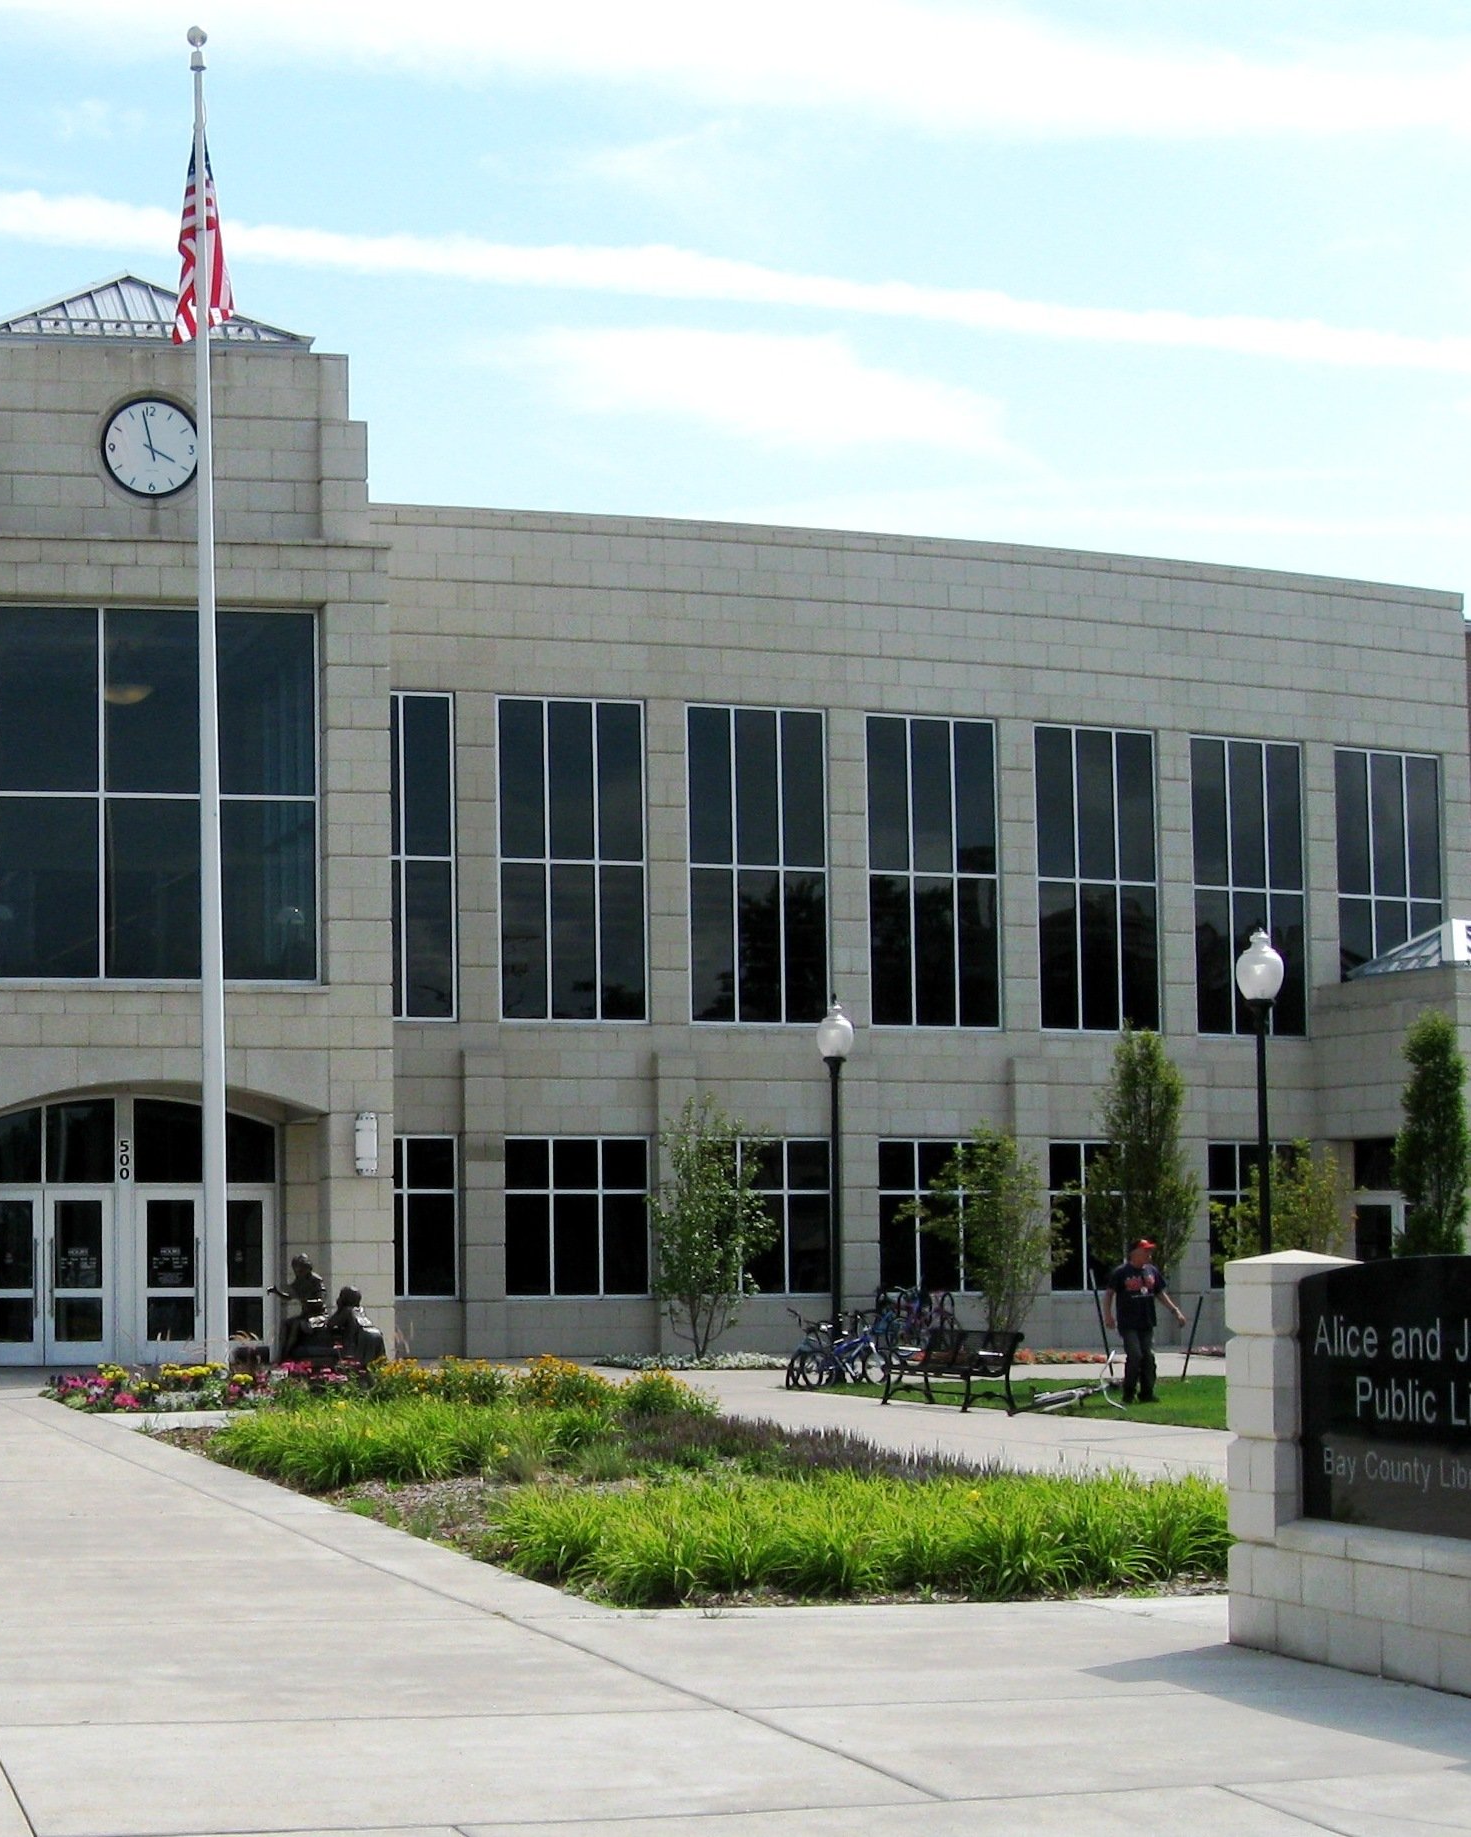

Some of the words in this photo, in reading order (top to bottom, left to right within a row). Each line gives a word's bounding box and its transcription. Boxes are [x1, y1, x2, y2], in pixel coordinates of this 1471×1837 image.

[145, 406, 156, 417] 12
[108, 443, 116, 452] 9
[188, 445, 195, 455] 3
[148, 482, 156, 492] 6
[120, 1140, 130, 1180] 500
[1313, 1315, 1378, 1358] Alice
[1391, 1317, 1441, 1361] and
[1455, 1318, 1469, 1363] J
[1355, 1376, 1437, 1424] Public
[1323, 1447, 1356, 1485] Bay
[1365, 1451, 1431, 1493] County
